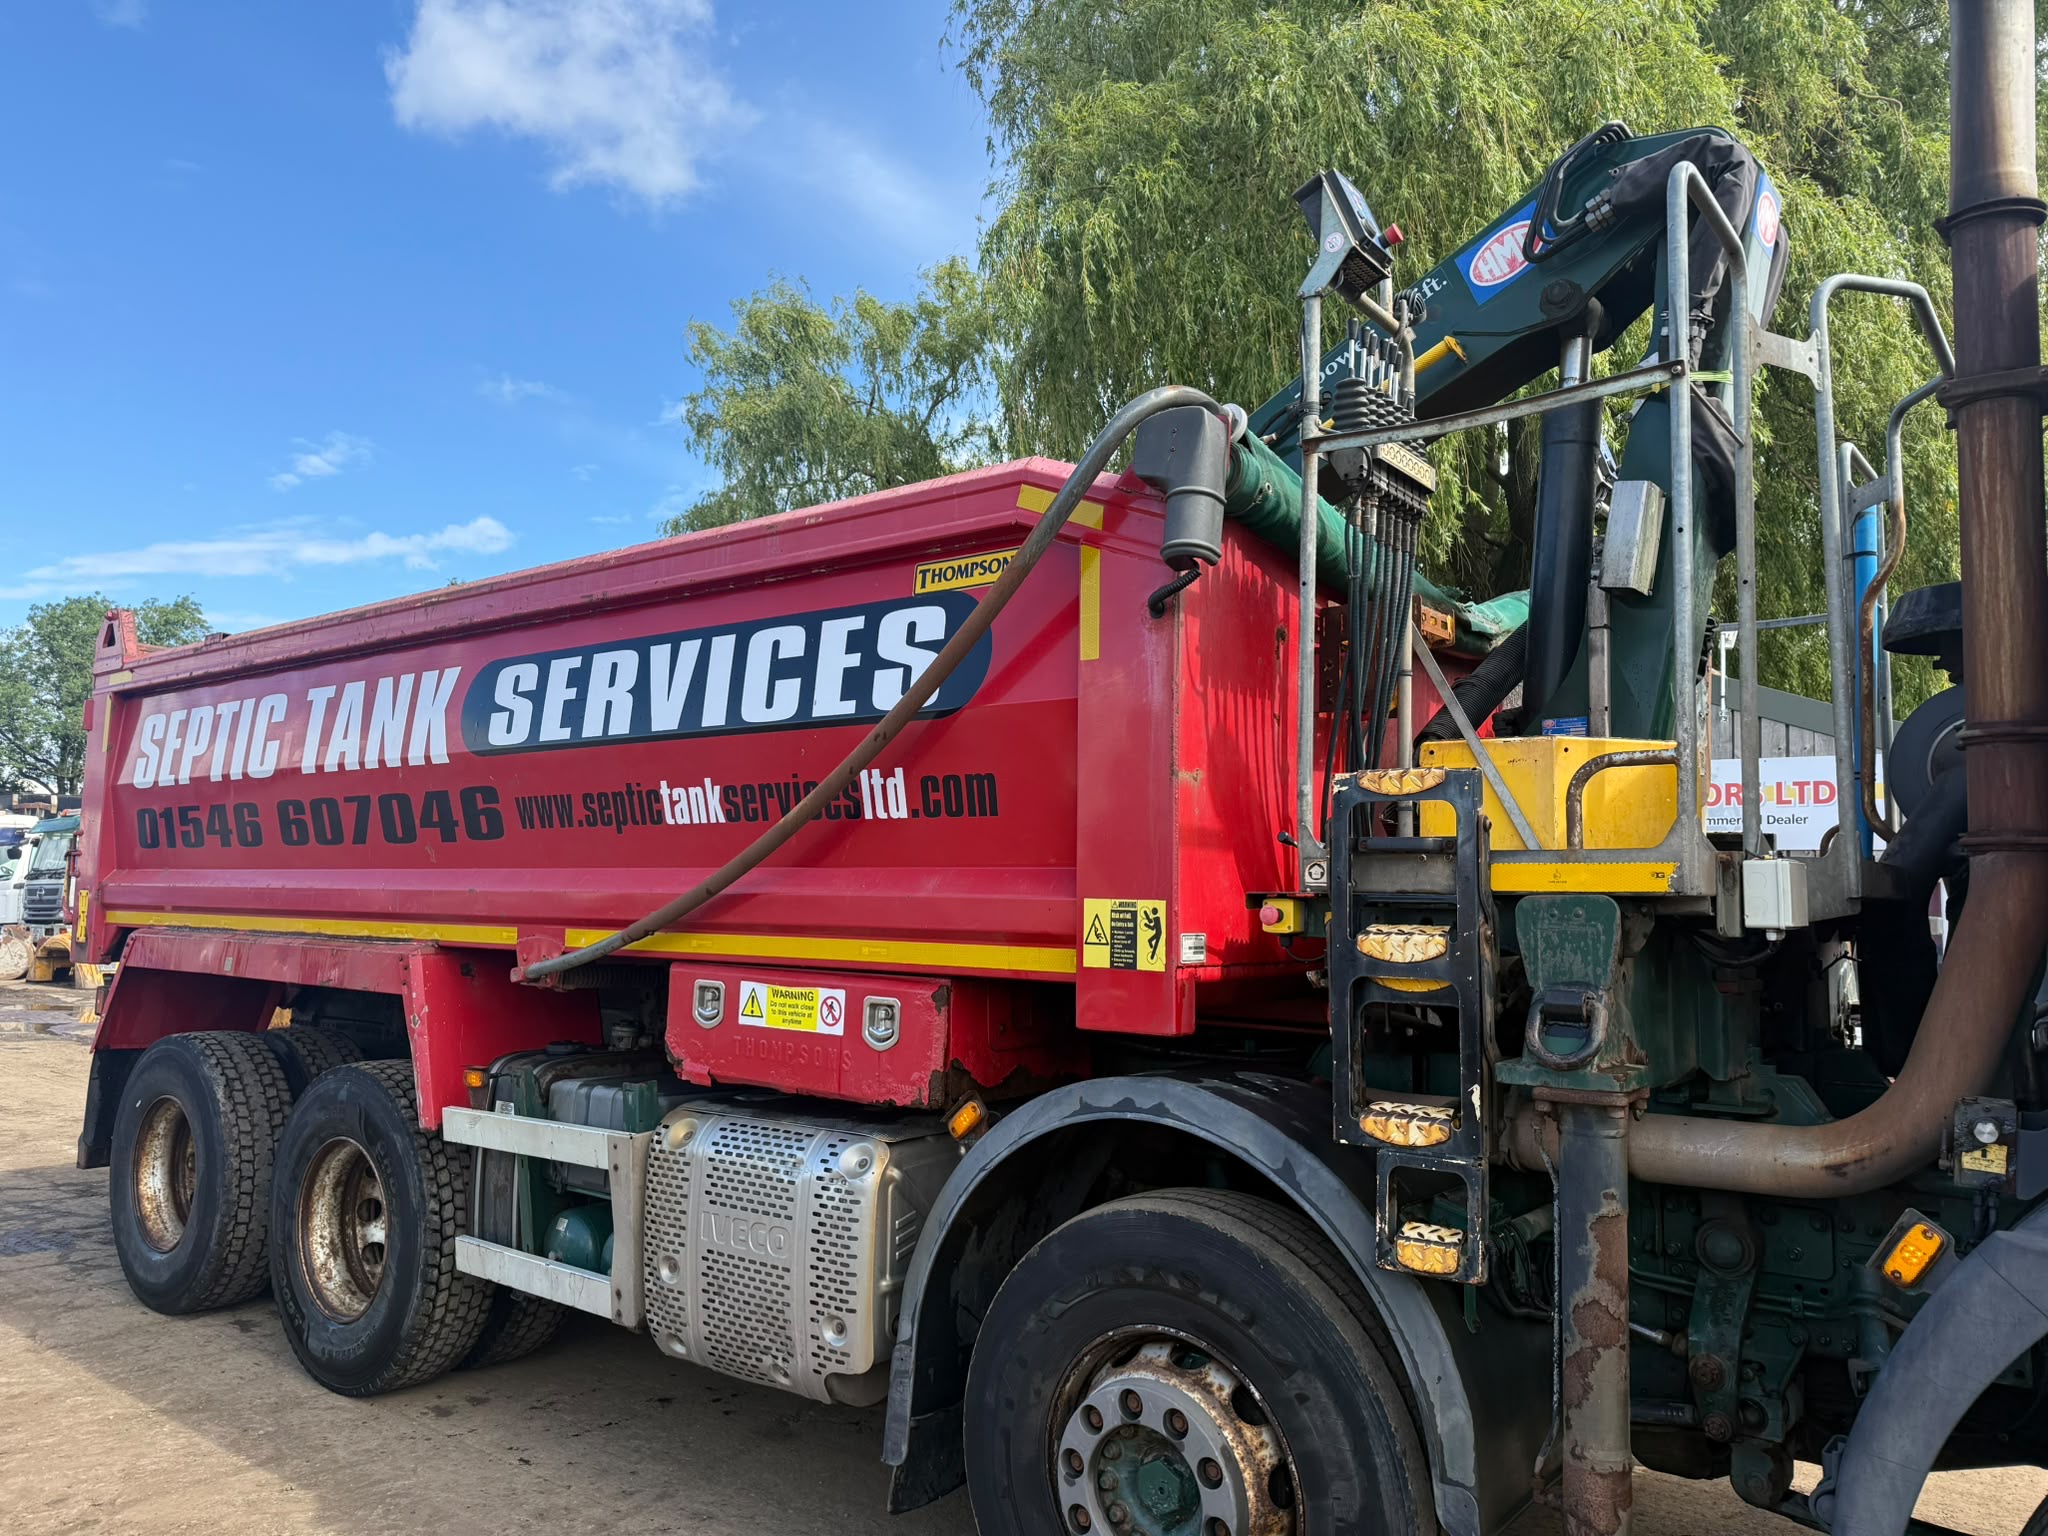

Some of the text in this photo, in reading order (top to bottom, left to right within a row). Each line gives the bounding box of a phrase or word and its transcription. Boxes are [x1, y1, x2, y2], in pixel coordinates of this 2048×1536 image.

[133, 605, 947, 789] SEPTIC TANK SERVICES
[1775, 780, 1836, 805] LTD
[136, 801, 263, 850] 01546
[277, 785, 505, 847] 607046
[1766, 814, 1809, 826] Dealer
[771, 989, 814, 1002] WARNING
[732, 1035, 852, 1071] THOMPSONS
[700, 1210, 791, 1259] IVECO
